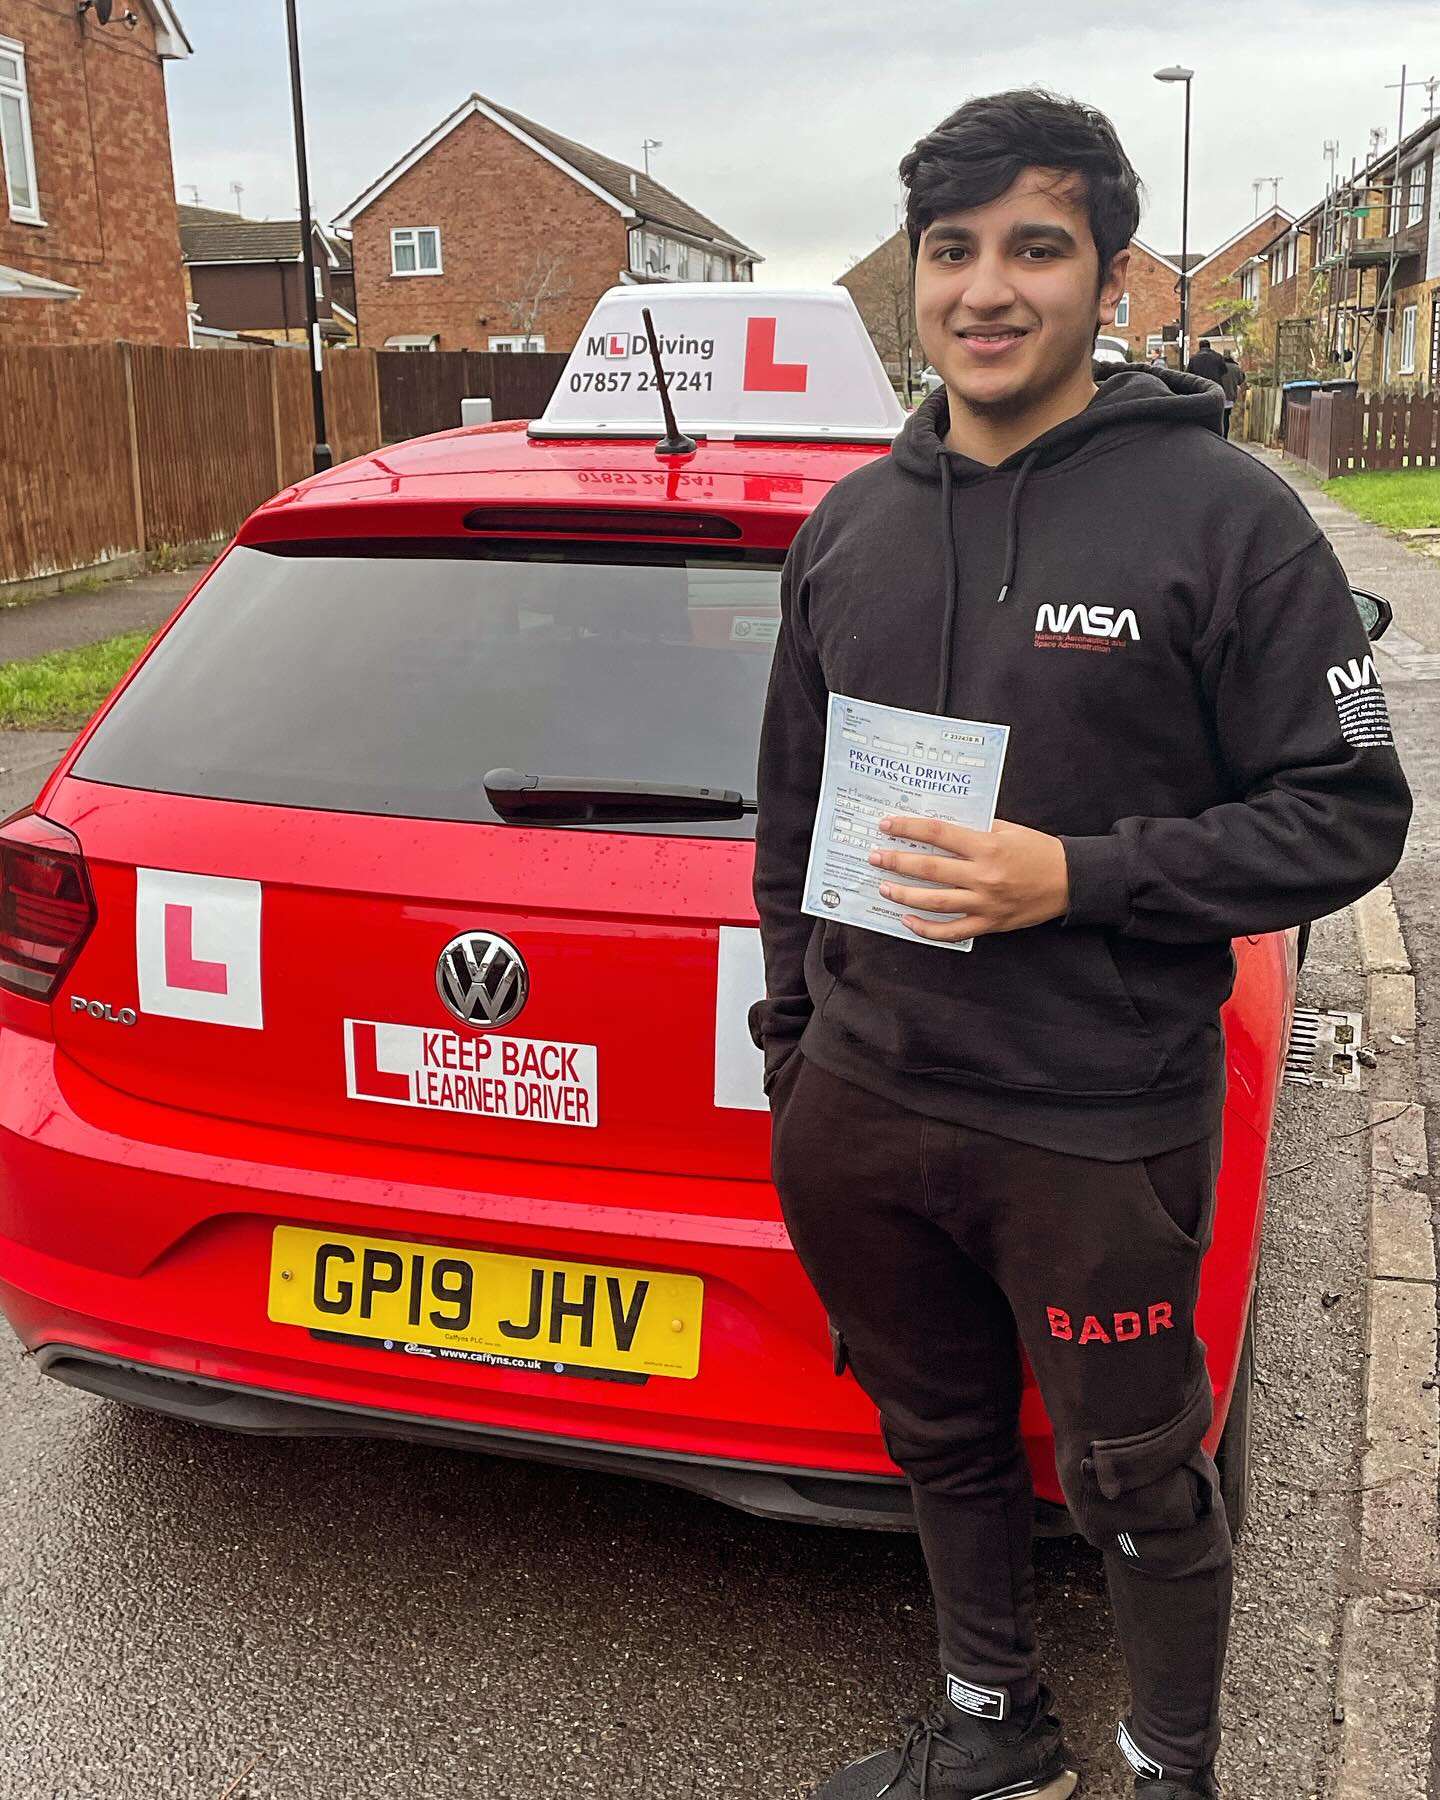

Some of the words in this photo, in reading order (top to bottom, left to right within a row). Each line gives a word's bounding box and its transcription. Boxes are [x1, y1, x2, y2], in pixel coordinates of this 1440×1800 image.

[632, 334, 714, 360] Diving
[743, 317, 808, 393] L
[570, 371, 632, 393] 07857
[637, 371, 713, 392] 247241
[1035, 603, 1141, 641] NASA
[849, 749, 911, 775] PRACTICAL
[915, 766, 972, 785] DRIVING
[850, 760, 872, 774] TEST
[874, 768, 898, 782] PASS
[901, 775, 969, 796] CERTIFICATE
[164, 903, 228, 995] L
[70, 995, 137, 1026] POLO
[352, 1021, 410, 1102] L
[422, 1032, 492, 1072] KEEP
[501, 1041, 580, 1083] BACK
[415, 1070, 508, 1115] LEARNER
[514, 1081, 590, 1124] DRIVER
[313, 1243, 474, 1331] GP19
[498, 1268, 650, 1352] JHV
[1046, 1301, 1175, 1345] BADR
[439, 1346, 541, 1370] www.caffyns.co.uk
